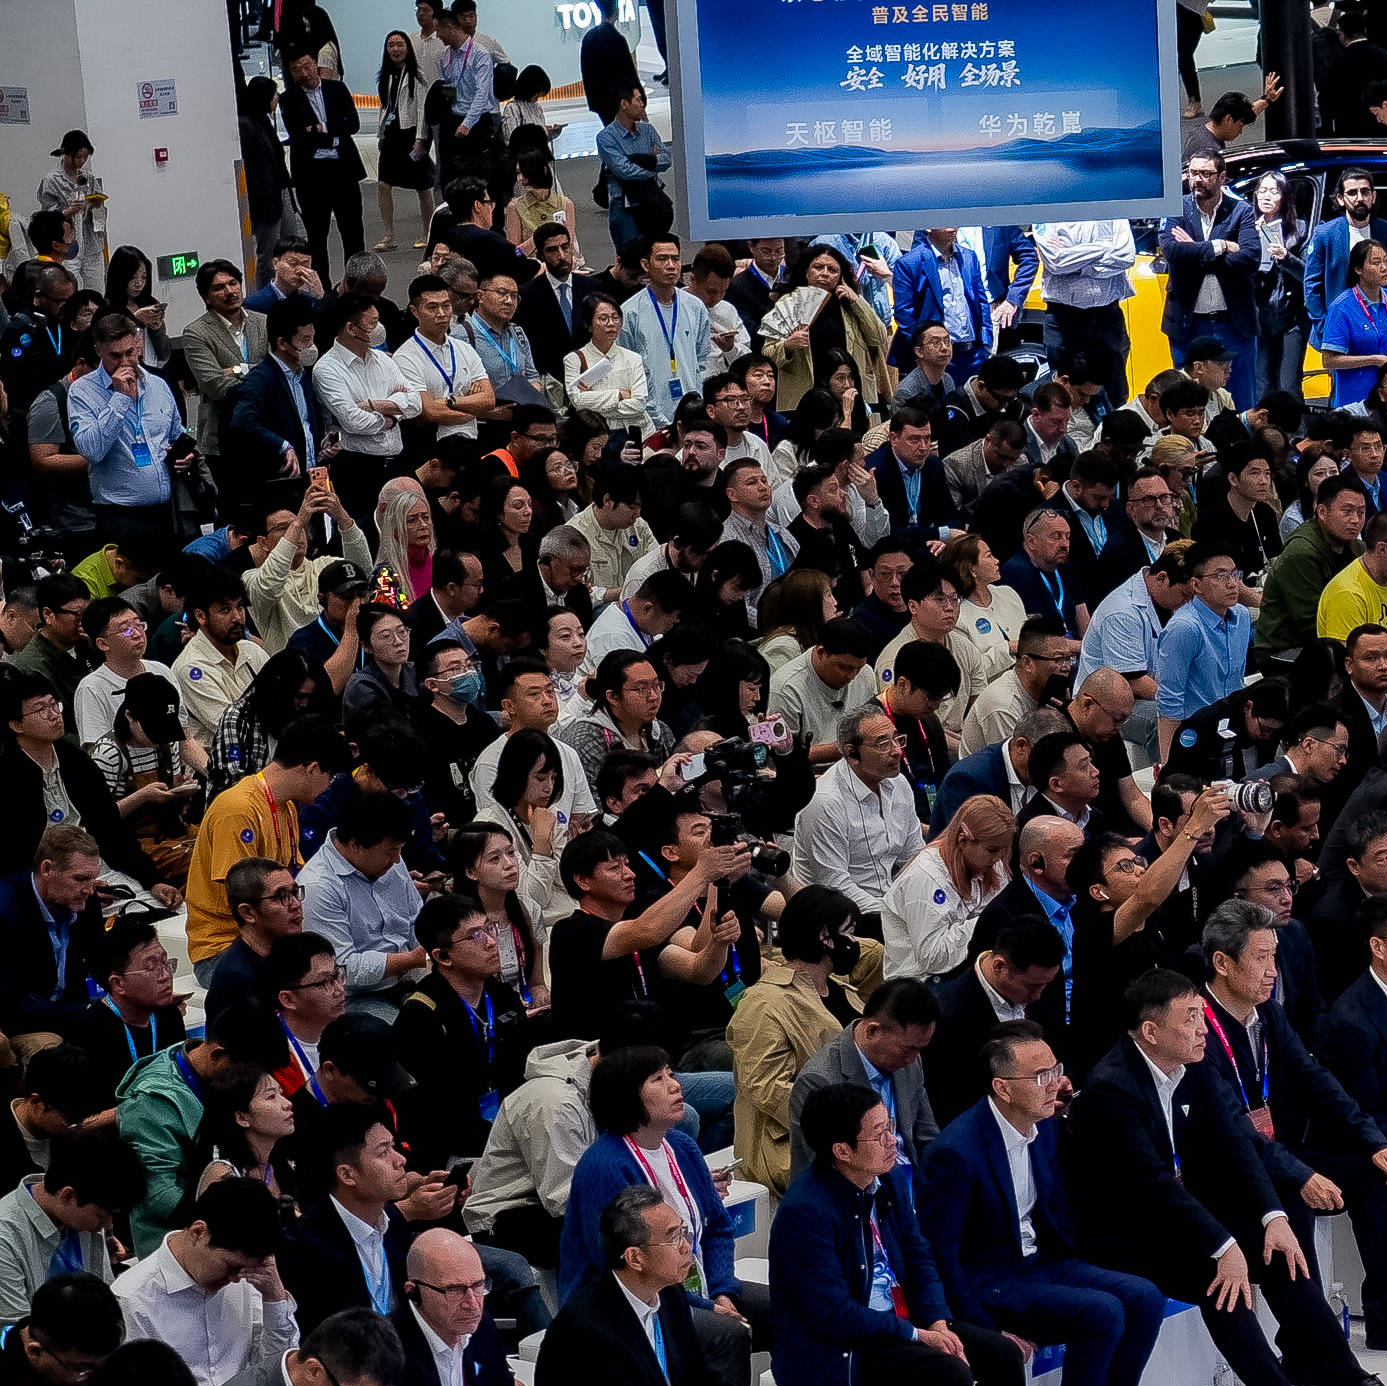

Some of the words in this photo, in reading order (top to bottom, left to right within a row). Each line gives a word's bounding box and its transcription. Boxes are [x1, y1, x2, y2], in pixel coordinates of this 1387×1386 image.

[871, 3, 989, 26] 普及全民智能
[845, 39, 1016, 63] 全域智能化解决方案
[840, 67, 885, 91] 安全
[901, 64, 947, 90] 好用
[958, 60, 1021, 88] 全场景
[785, 117, 893, 146] 天枢智能
[978, 111, 1083, 136] 华为乾崑
